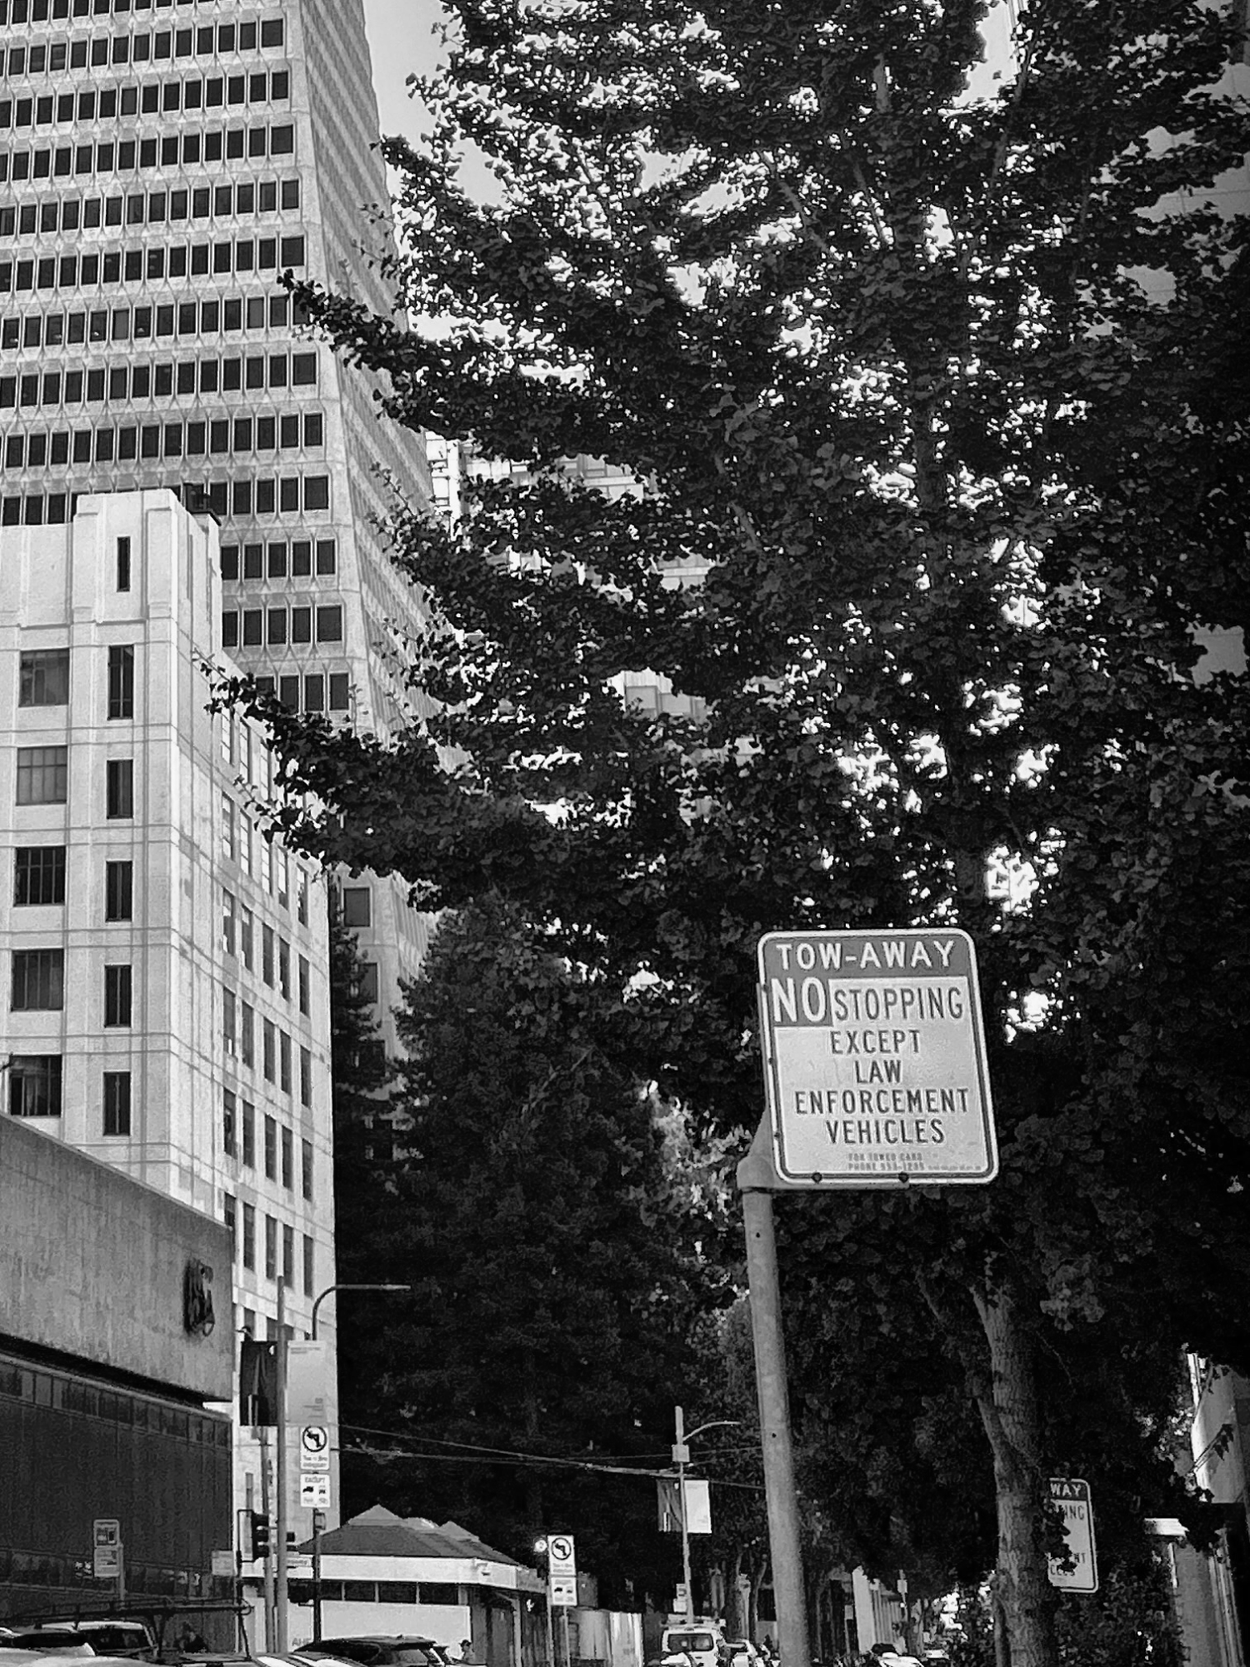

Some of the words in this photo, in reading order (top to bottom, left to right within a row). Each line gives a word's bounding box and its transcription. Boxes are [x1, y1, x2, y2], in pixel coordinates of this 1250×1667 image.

[775, 940, 954, 971] TOW-AWAY
[770, 976, 827, 1023] NO
[833, 986, 964, 1021] STOPPING
[830, 1029, 920, 1055] EXCEPT
[854, 1059, 901, 1085] LAW
[794, 1087, 969, 1115] ENFORCEMENT
[825, 1118, 945, 1145] VEHICLES
